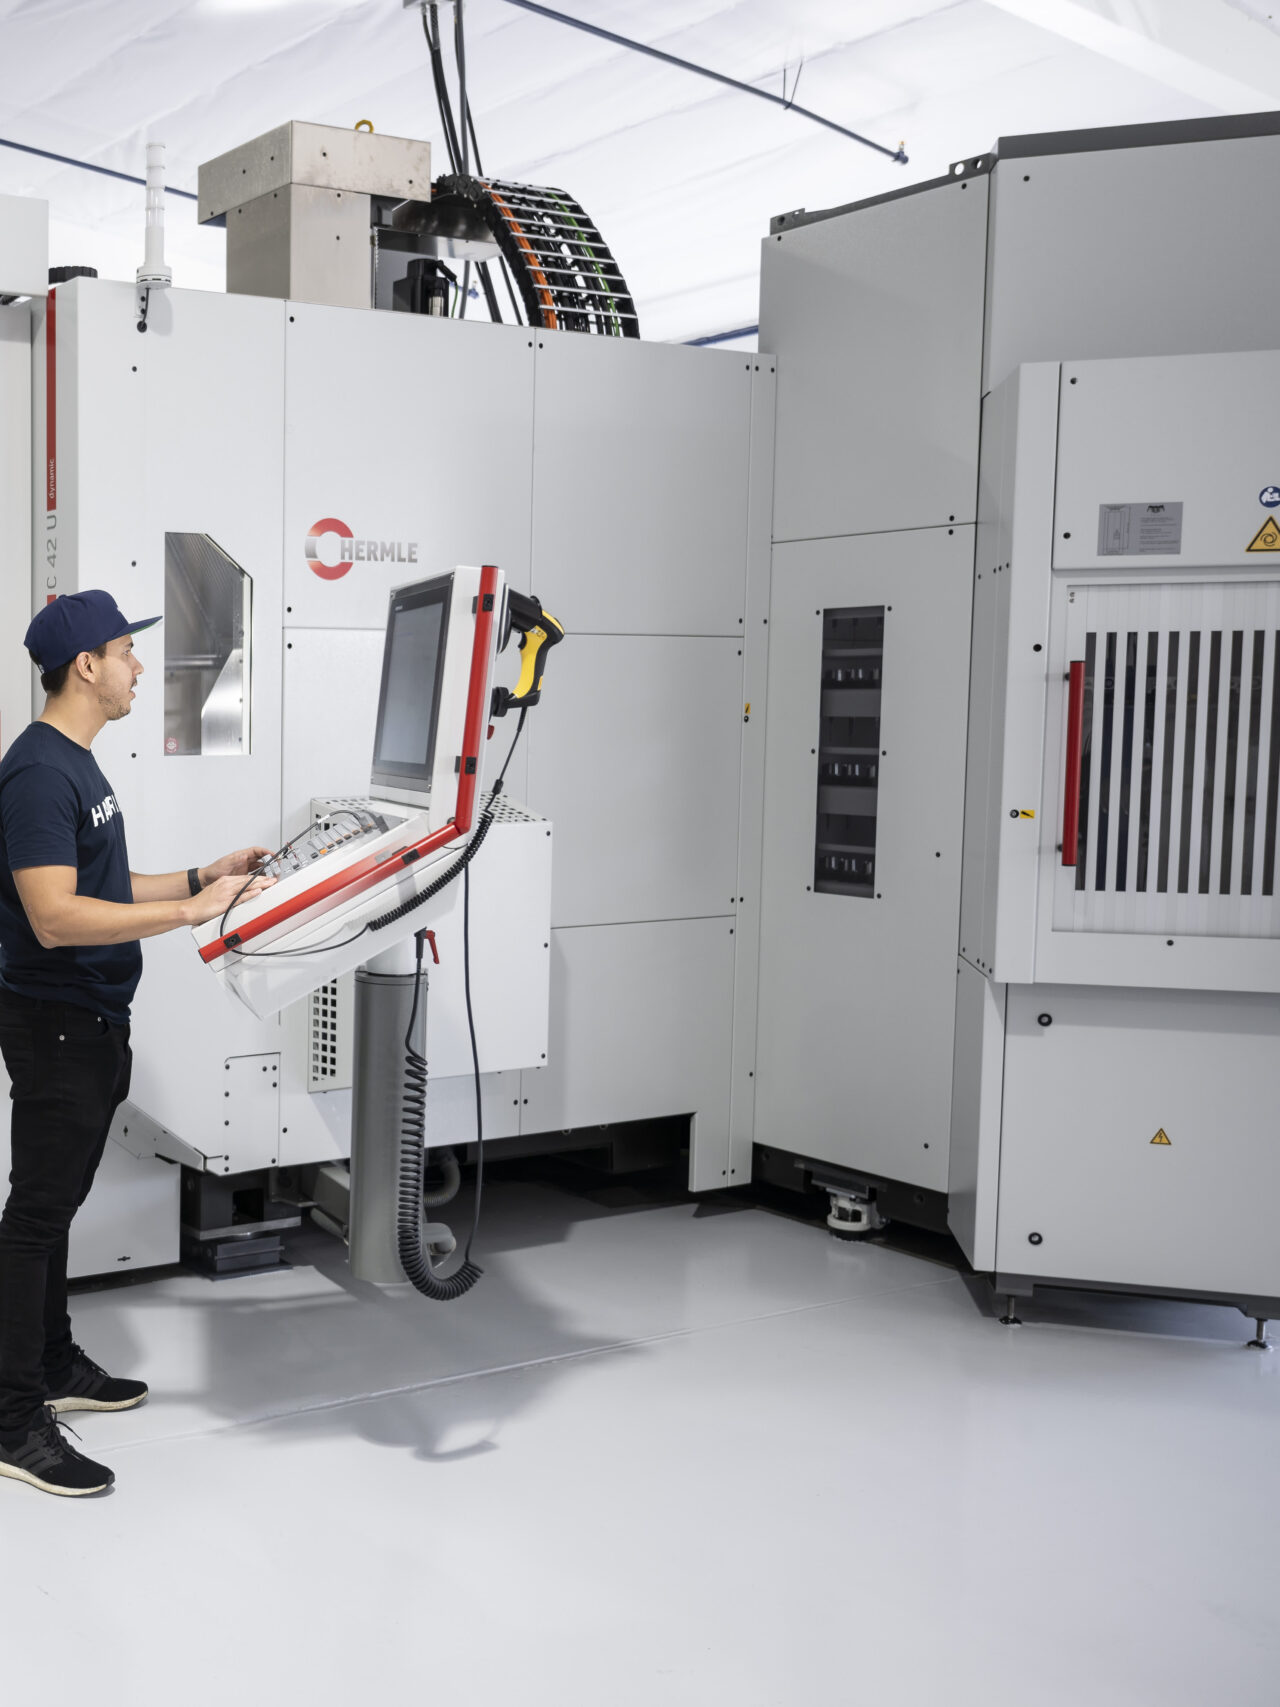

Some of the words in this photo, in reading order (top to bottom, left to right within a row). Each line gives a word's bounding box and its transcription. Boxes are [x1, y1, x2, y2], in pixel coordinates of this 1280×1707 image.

[46, 514, 57, 530] U
[46, 538, 57, 568] 42
[340, 539, 418, 563] HERMLE
[46, 576, 57, 589] C
